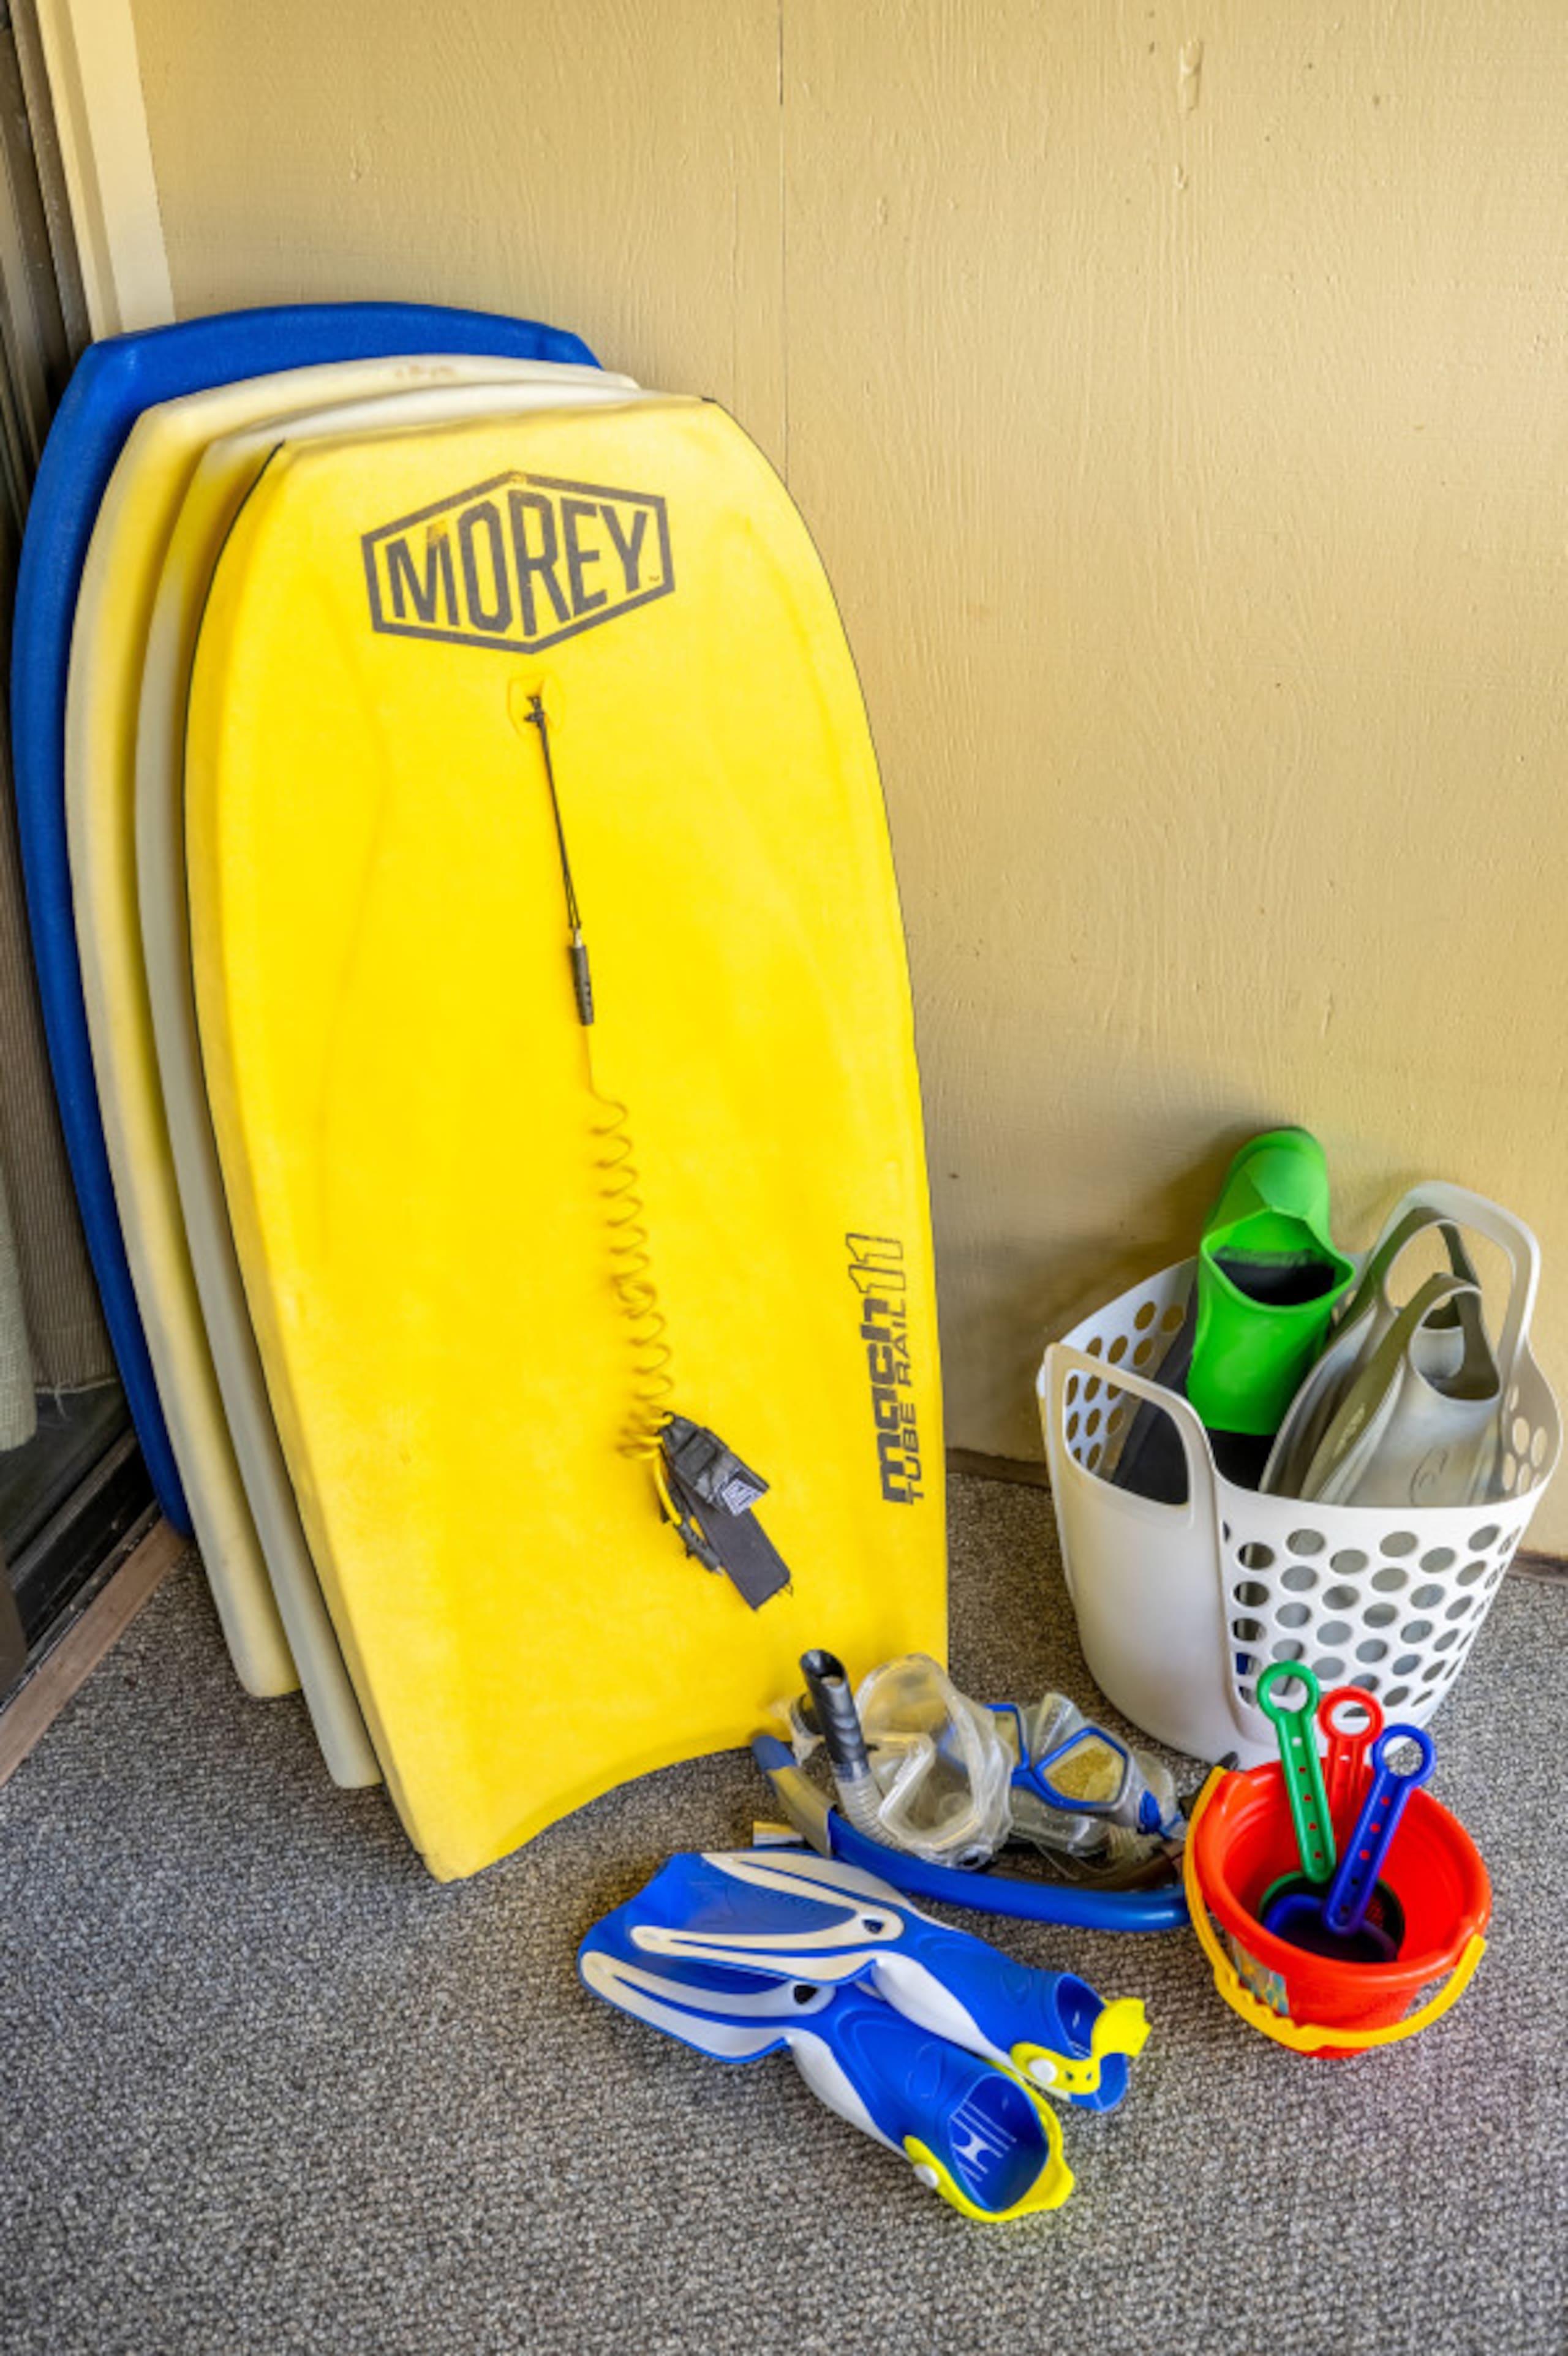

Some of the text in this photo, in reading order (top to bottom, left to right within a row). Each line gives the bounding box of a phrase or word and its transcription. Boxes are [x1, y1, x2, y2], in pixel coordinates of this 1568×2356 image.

[385, 489, 648, 636] MOREY
[891, 1299, 924, 1505] TUBE RAIL
